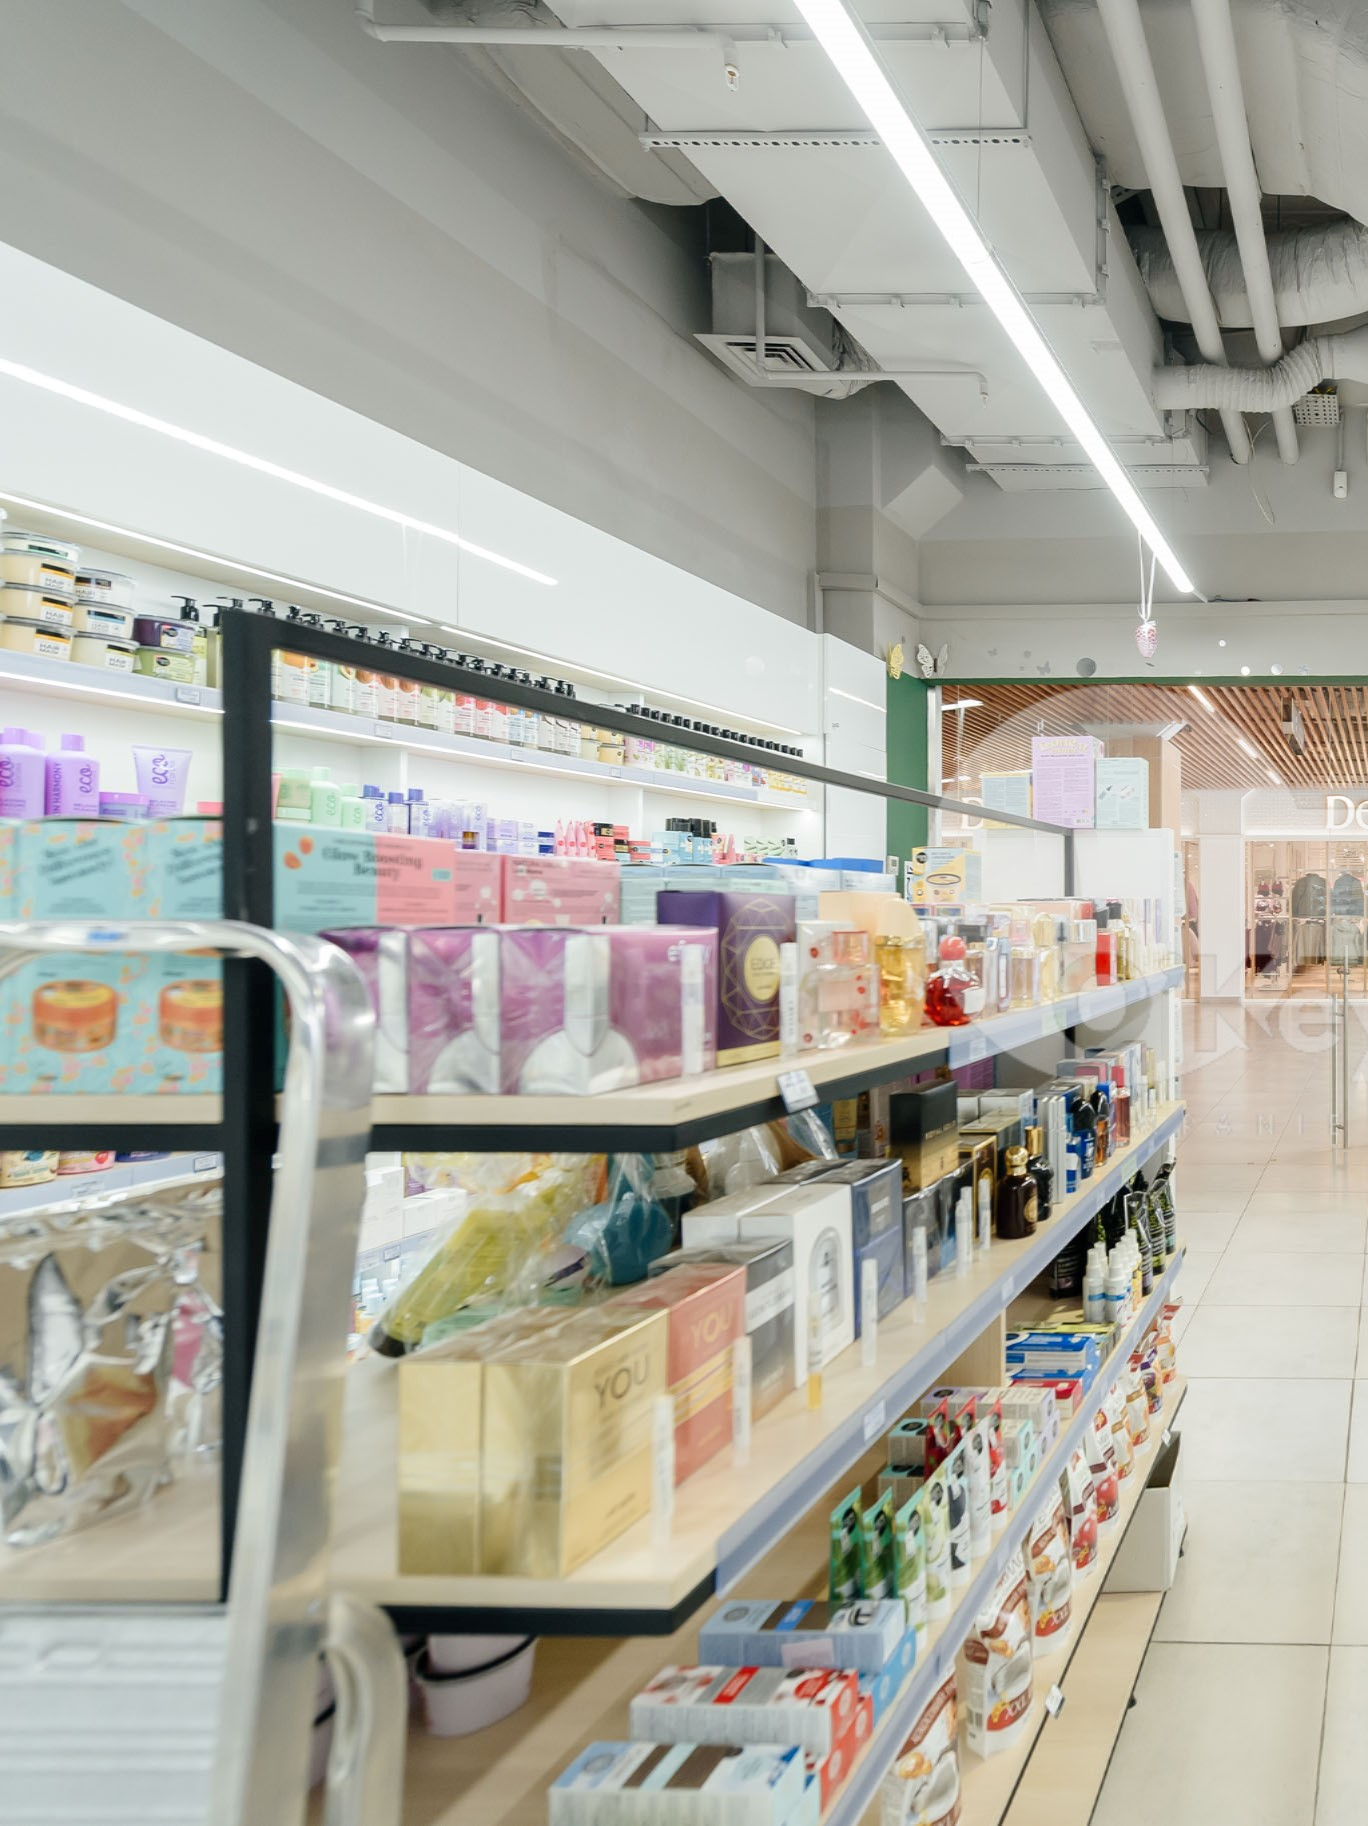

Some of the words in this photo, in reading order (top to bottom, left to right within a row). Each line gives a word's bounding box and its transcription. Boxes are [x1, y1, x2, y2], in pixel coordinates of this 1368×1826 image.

[53, 763, 62, 803] HARMONY
[79, 764, 93, 794] eco
[375, 800, 385, 822] eco
[690, 1301, 733, 1349] YOU
[594, 1354, 650, 1408] YOU
